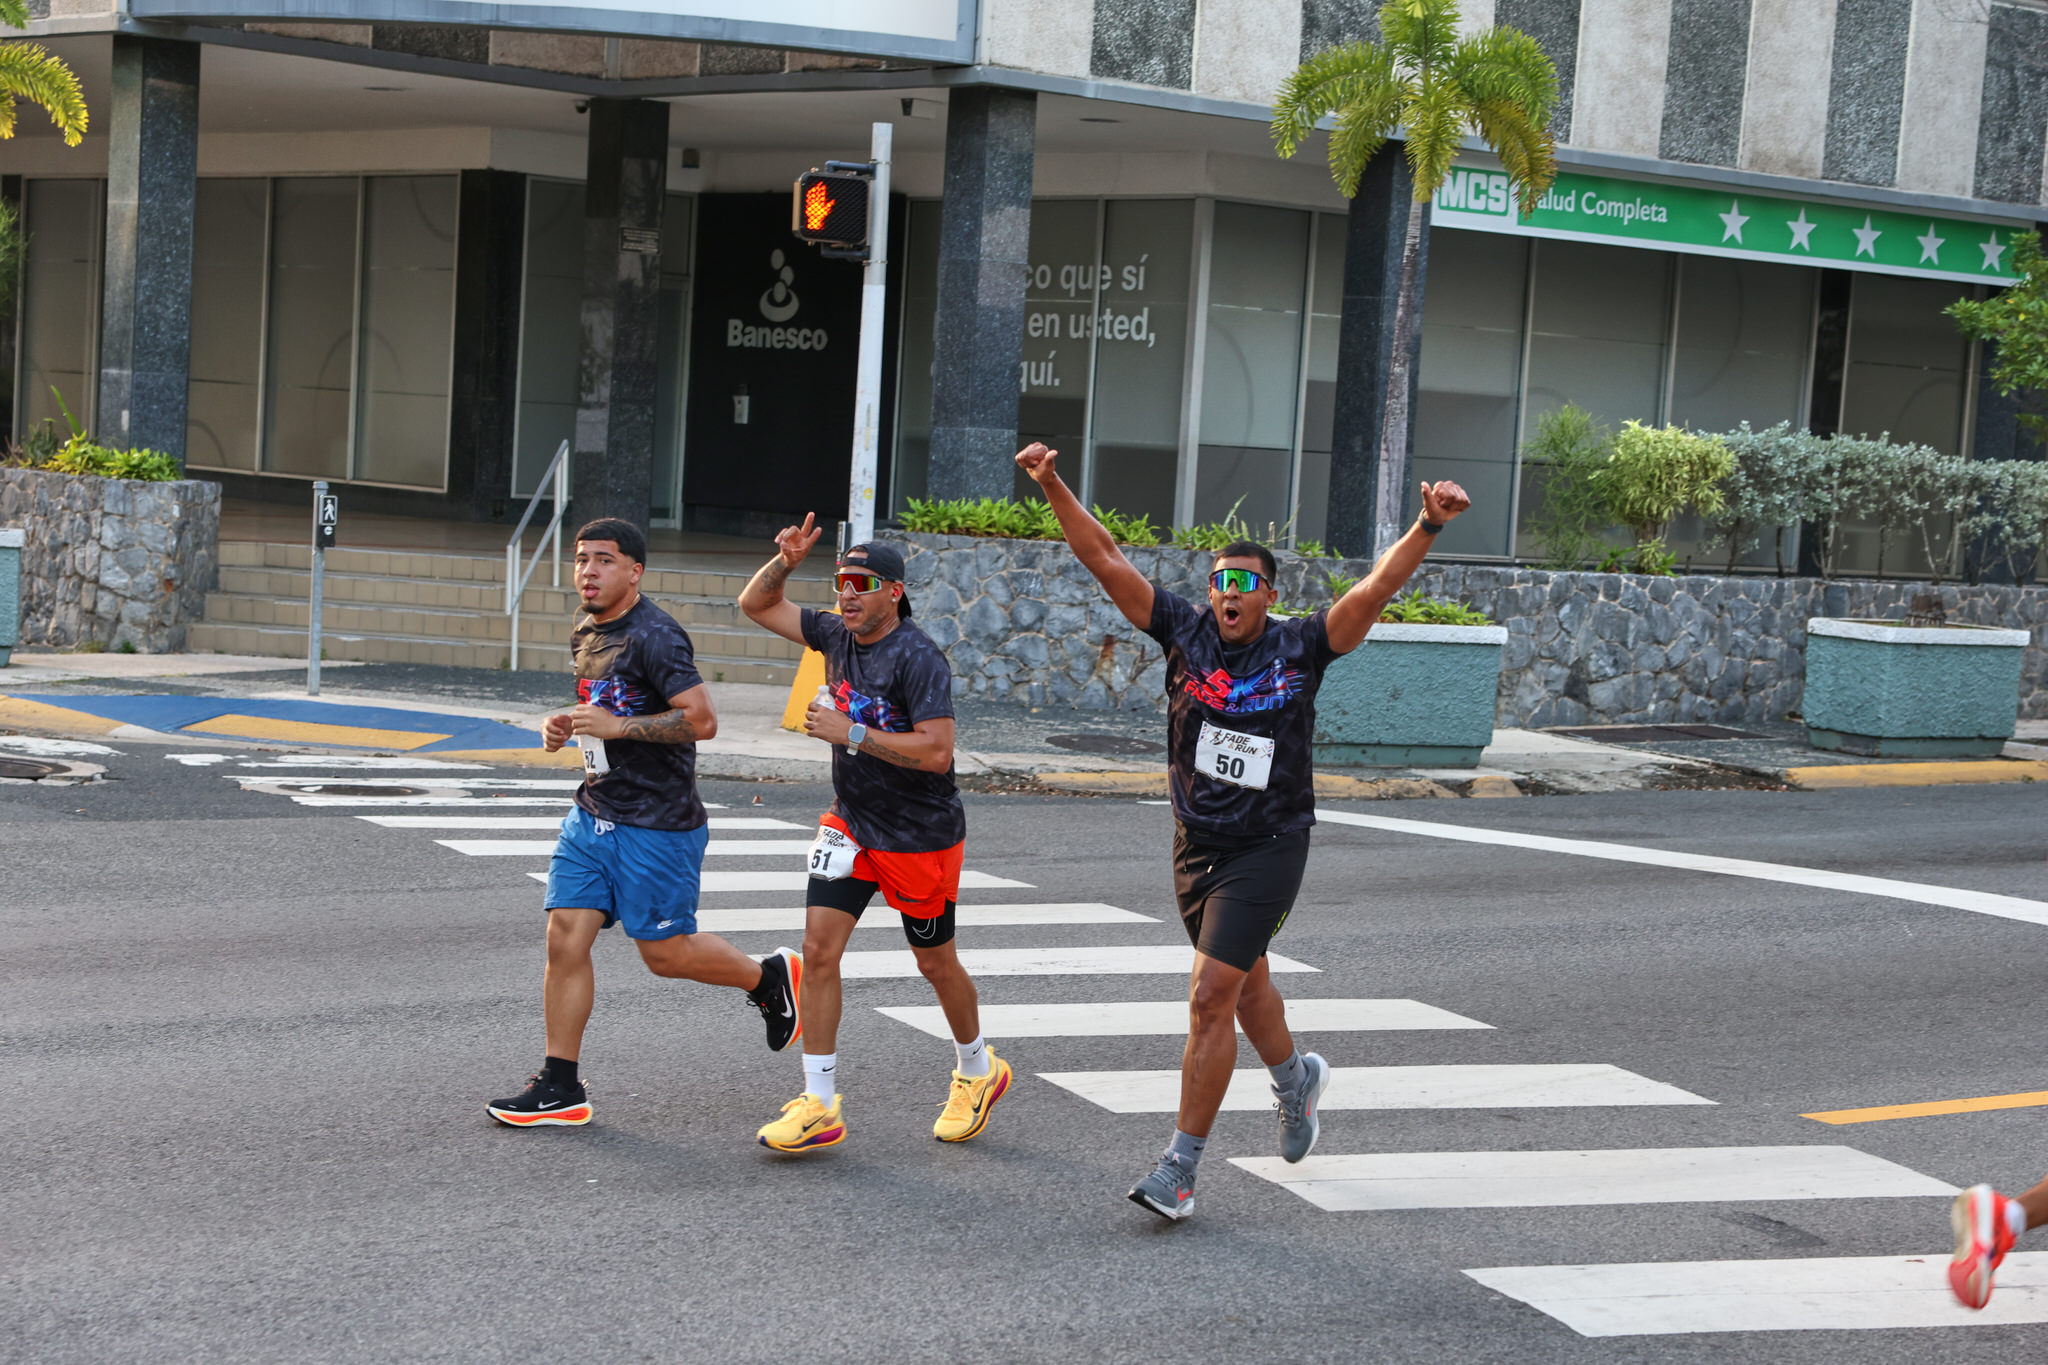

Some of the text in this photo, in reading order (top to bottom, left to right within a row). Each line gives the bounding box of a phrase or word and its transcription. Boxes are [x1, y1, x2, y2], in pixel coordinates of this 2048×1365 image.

[1440, 170, 1509, 213] MCS
[1533, 187, 1669, 226] alud Completa
[1024, 253, 1149, 297] co que sí
[727, 319, 828, 351] Banesco
[1028, 307, 1156, 348] en usted,
[1020, 351, 1061, 393] quí.
[1184, 680, 1285, 713] FADE & RUN
[1201, 667, 1271, 702] 5K
[1223, 732, 1251, 746] FADE
[1235, 744, 1258, 755] RUN
[585, 750, 596, 769] 52
[1216, 753, 1245, 779] 50
[811, 849, 832, 871] 51
